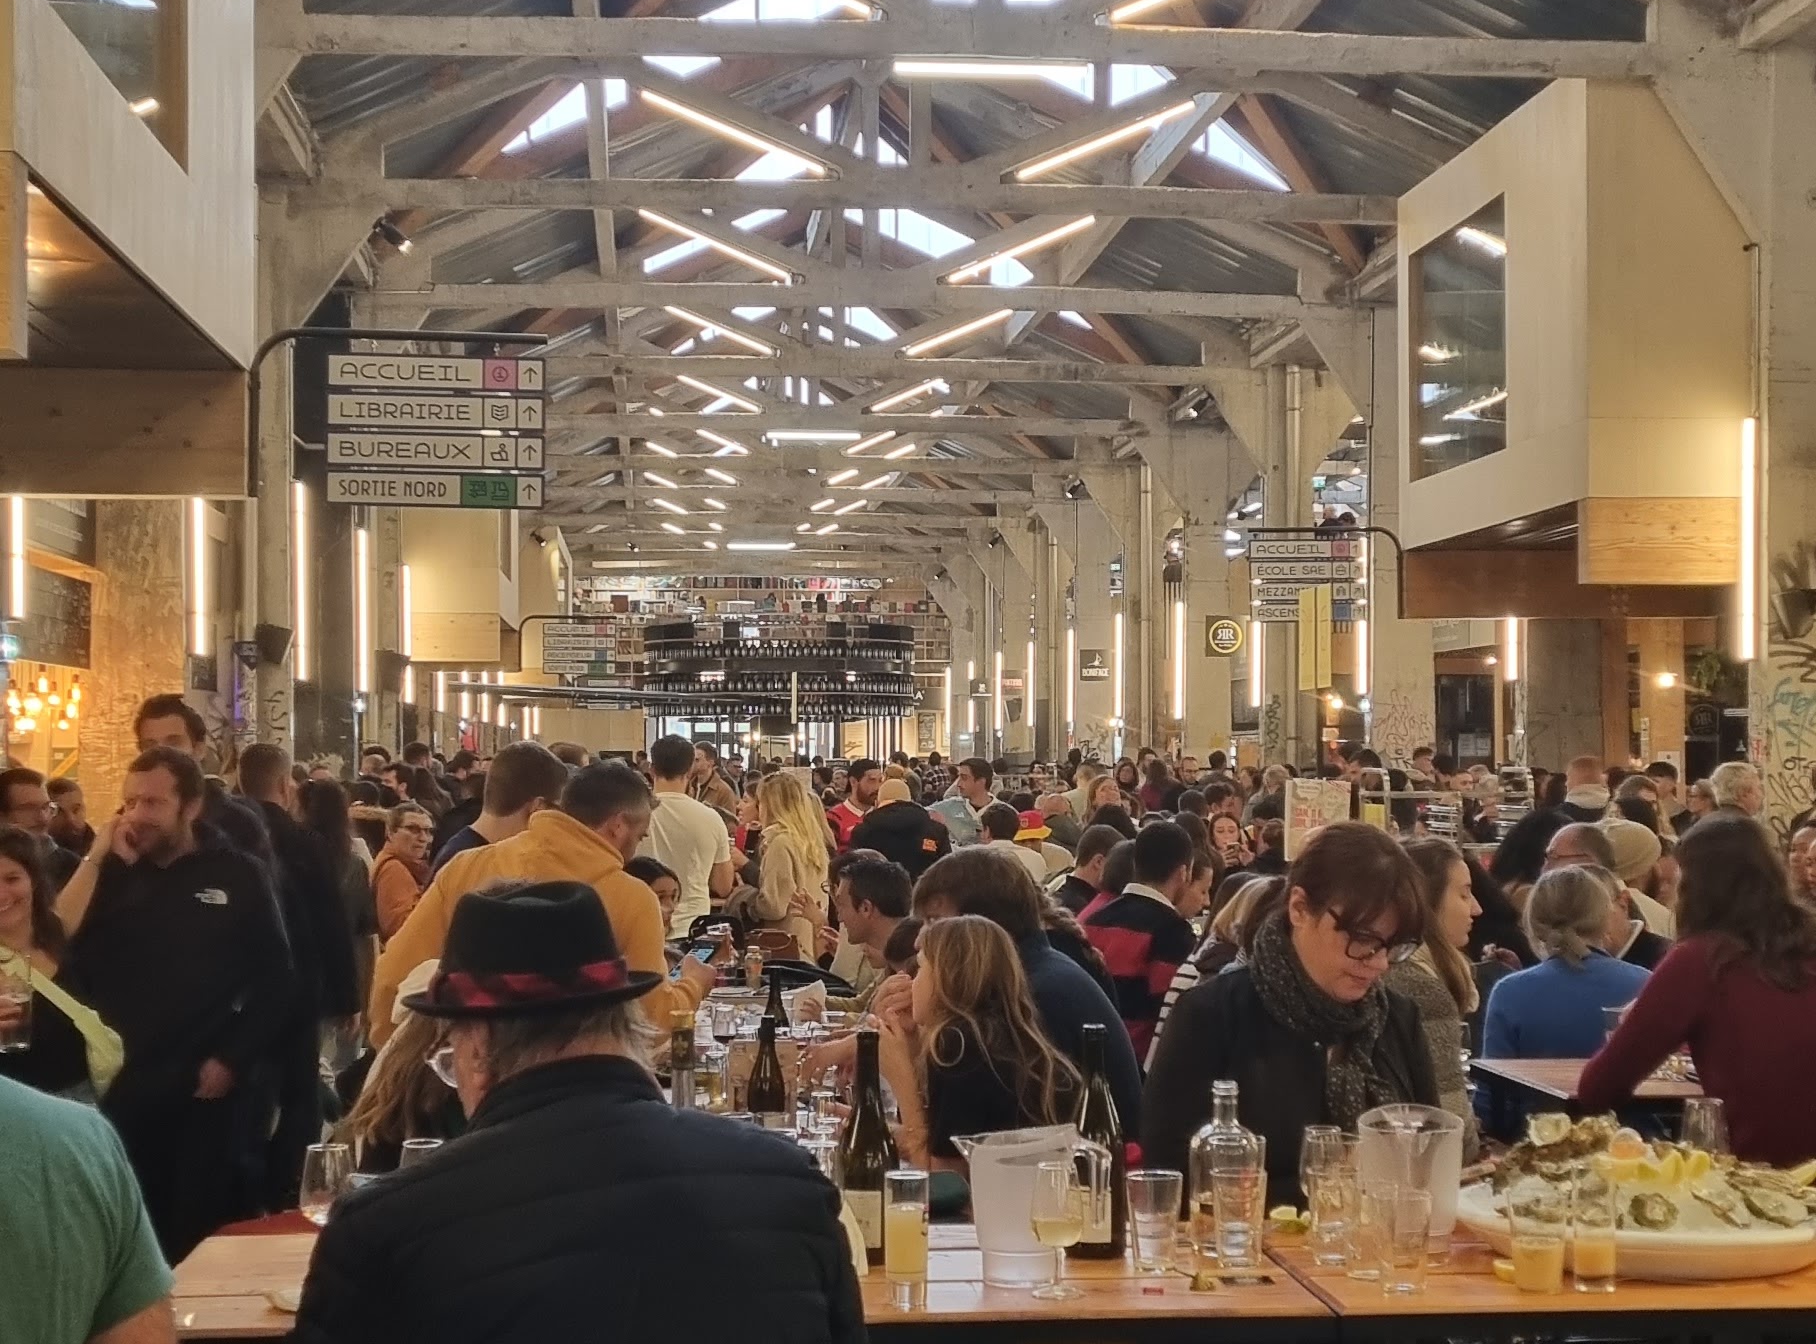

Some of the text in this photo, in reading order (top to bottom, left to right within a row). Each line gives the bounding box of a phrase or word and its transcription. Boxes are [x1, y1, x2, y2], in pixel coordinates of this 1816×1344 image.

[340, 362, 471, 382] ACCUEIL
[340, 401, 471, 421] LIBRAIRIE
[339, 440, 471, 460] BUREAUX
[338, 479, 447, 498] SORTIE NORD
[1256, 544, 1326, 554] ACCUEIL
[1257, 563, 1326, 576] ÉCOLE SAE
